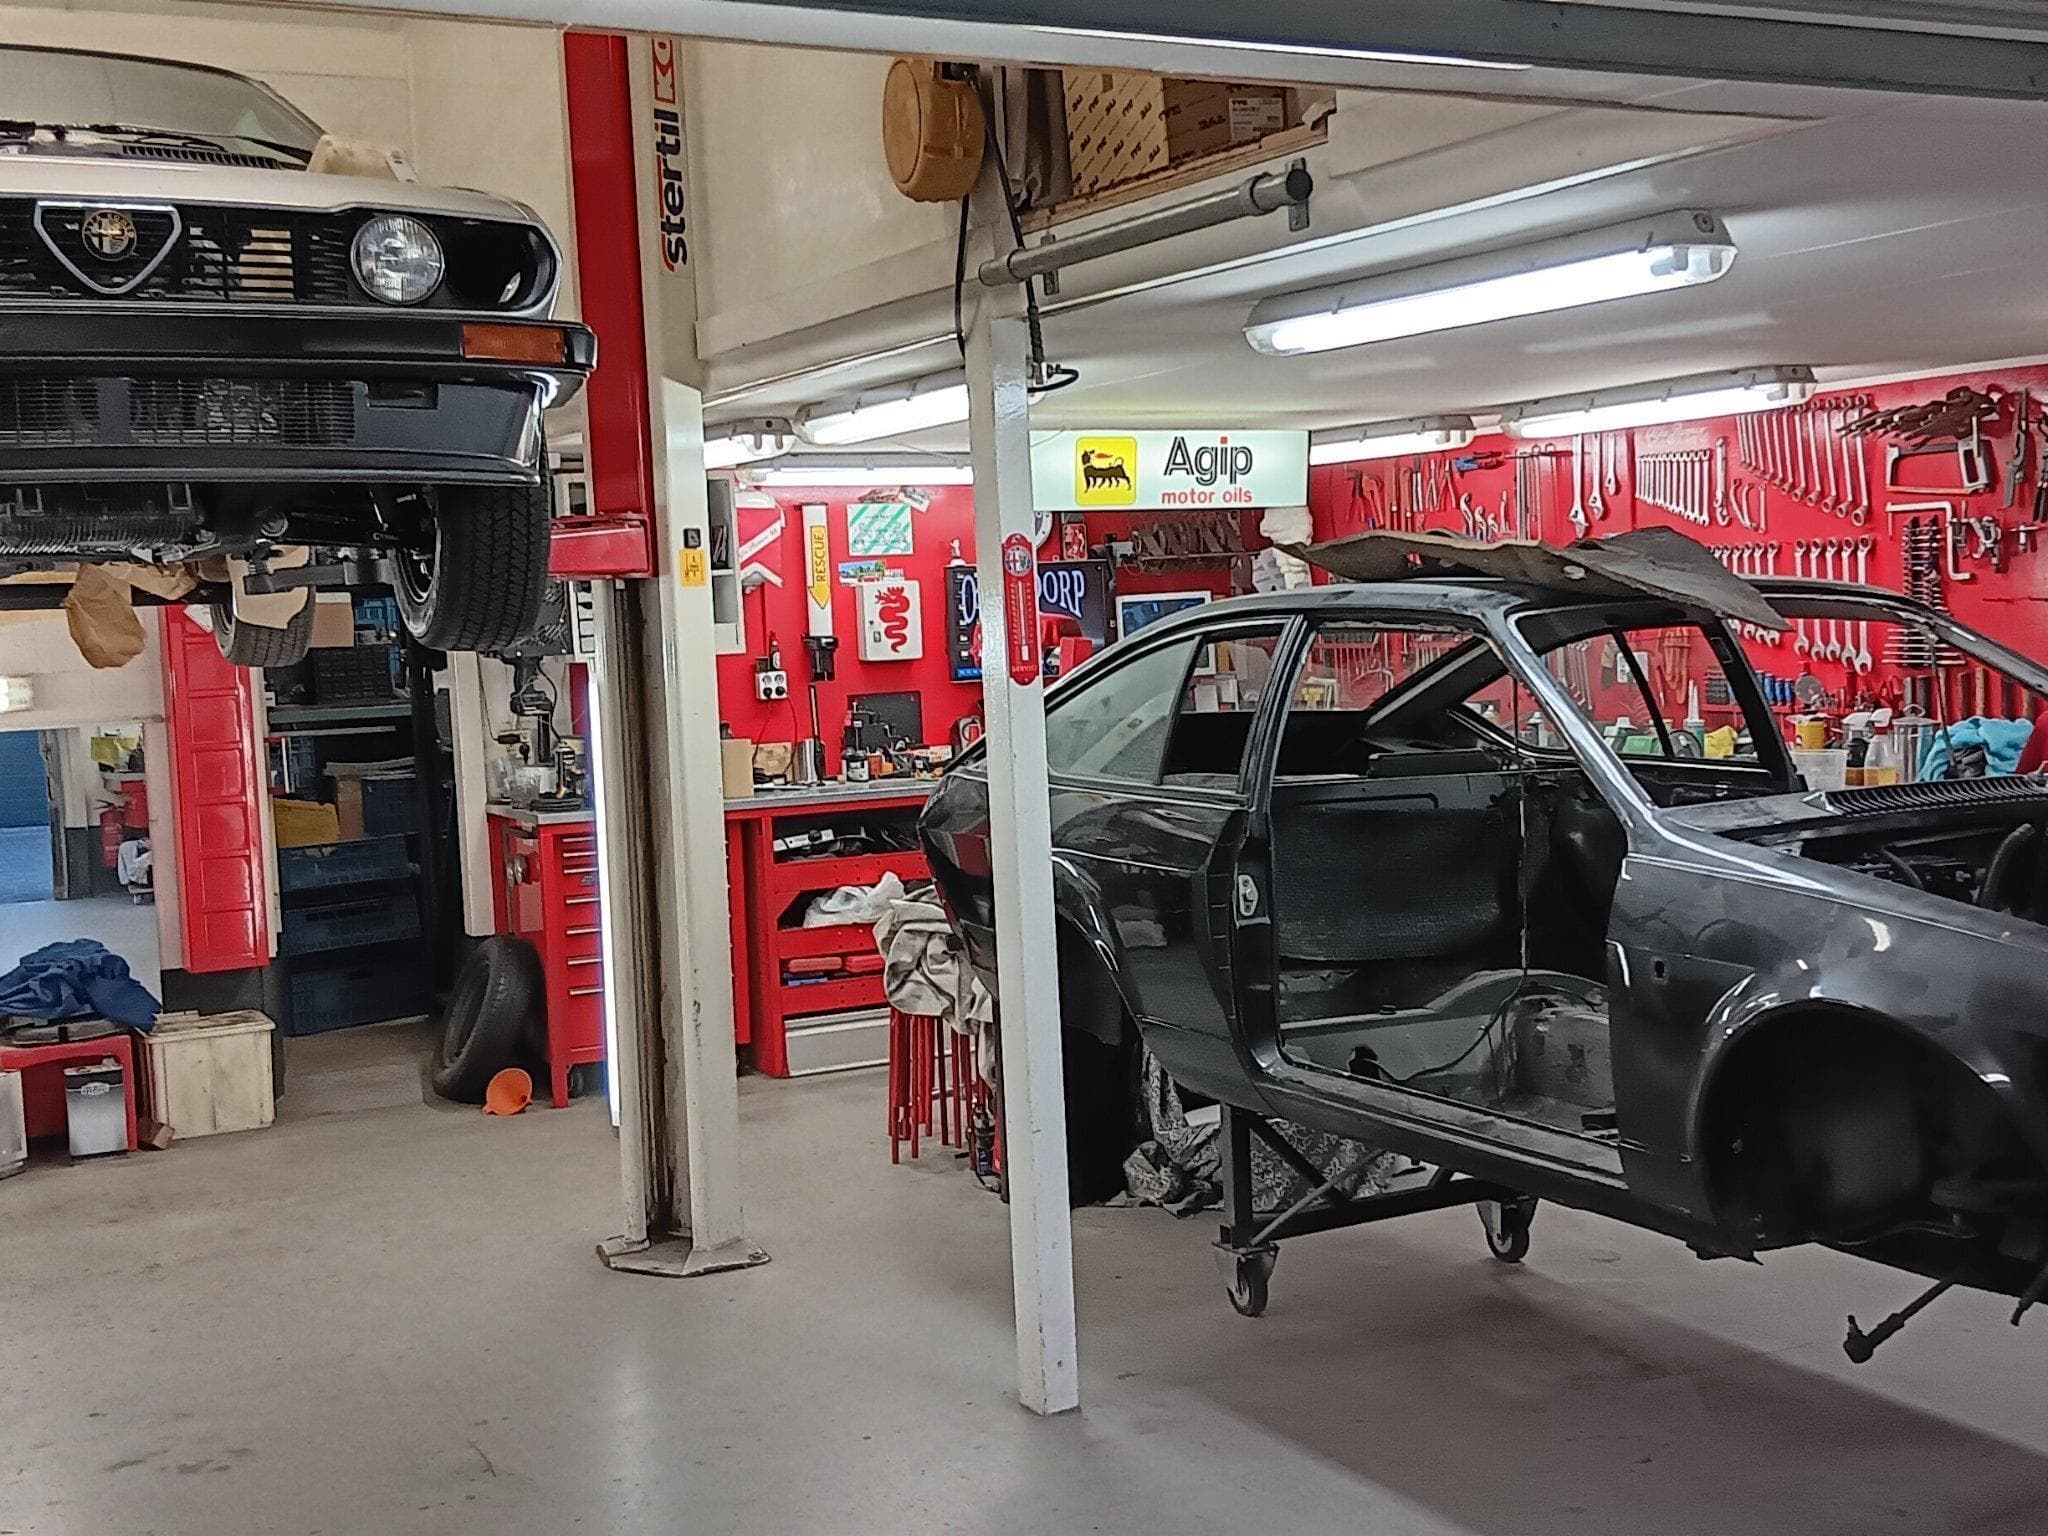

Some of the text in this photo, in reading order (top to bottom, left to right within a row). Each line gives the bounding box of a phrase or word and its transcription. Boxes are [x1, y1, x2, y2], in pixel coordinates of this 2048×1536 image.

[654, 107, 687, 269] stertil
[1163, 436, 1253, 486] Agip
[1161, 486, 1253, 505] motor oils
[813, 533, 827, 582] RESCUE
